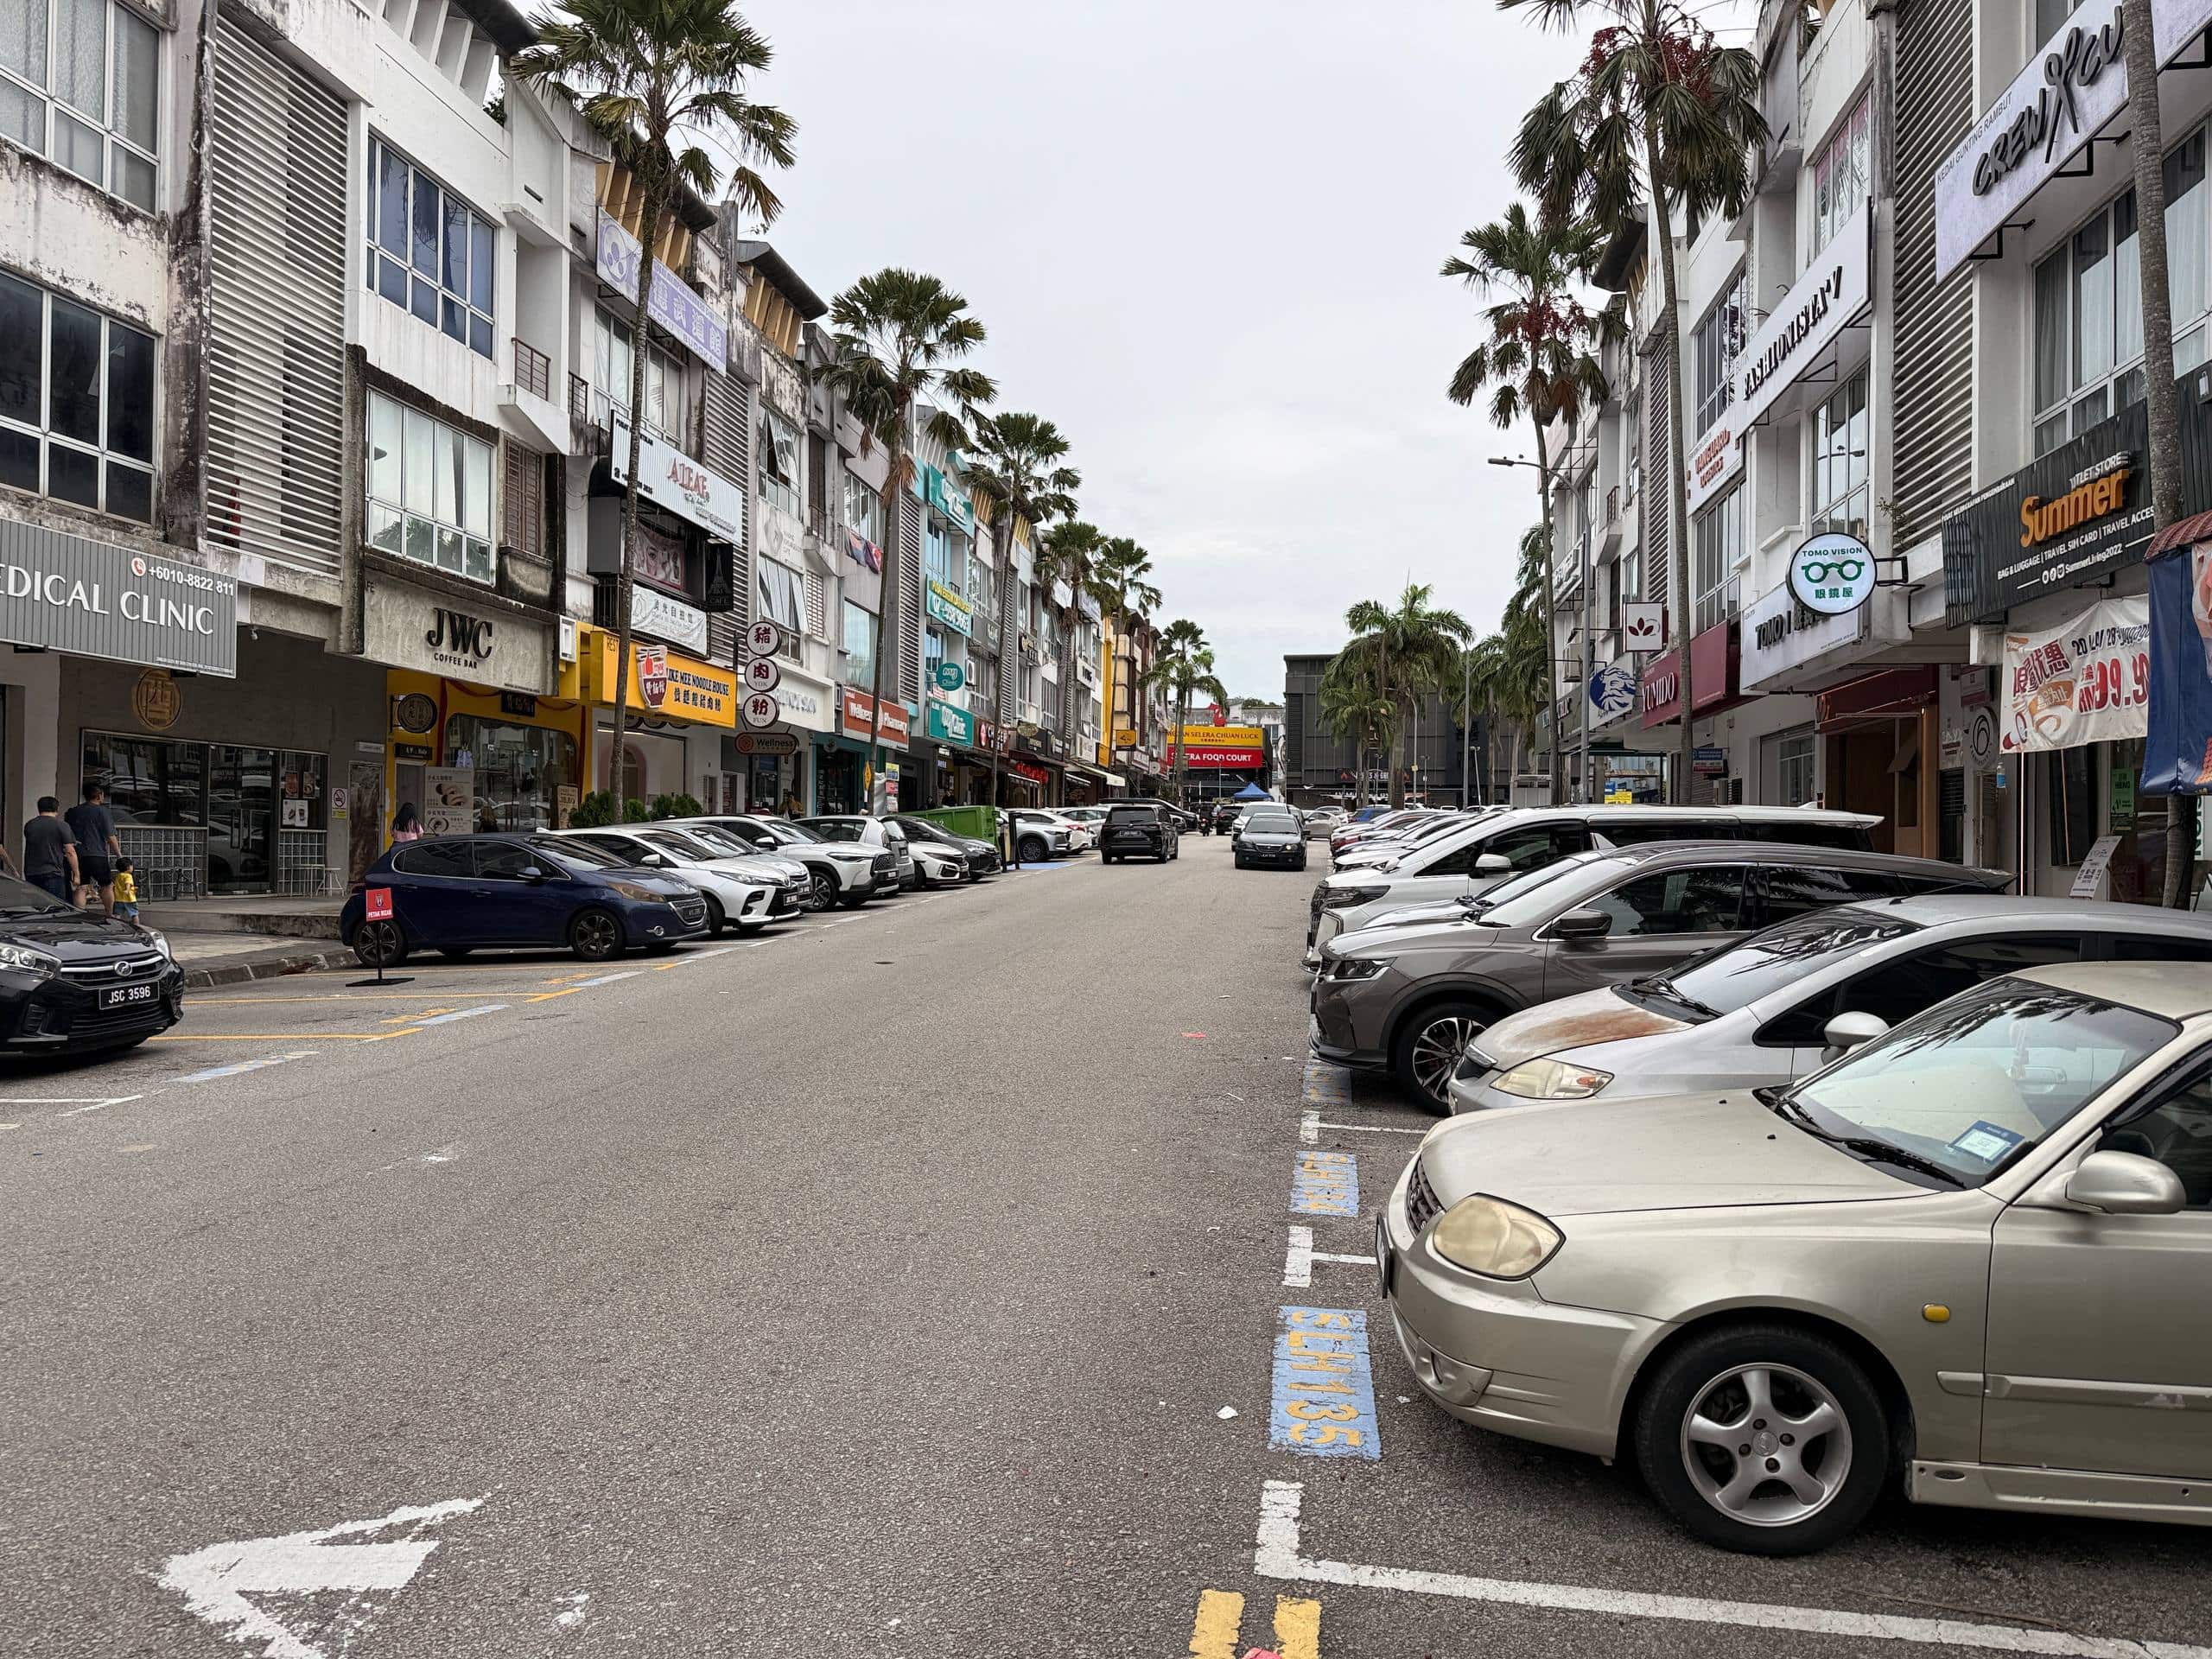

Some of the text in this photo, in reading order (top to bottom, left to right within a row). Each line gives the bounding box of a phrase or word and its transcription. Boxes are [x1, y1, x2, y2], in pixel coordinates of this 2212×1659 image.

[1936, 92, 2013, 185] KEDAI GUNTING RAMBUT
[1972, 87, 2047, 197] CREW
[2094, 452, 2126, 477] STORE
[2020, 469, 2130, 548] Summer
[1831, 546, 1863, 555] VISION
[1997, 566, 2009, 581] BAG
[2013, 555, 2041, 575] LUGGAGE
[2044, 541, 2067, 560] TRAVEL
[2079, 530, 2098, 549] CARD
[2103, 518, 2130, 539] TRAVEL
[149, 566, 213, 591] +6010-8822
[1815, 587, 1853, 599] 眼鏡屋
[119, 591, 214, 636] CLINIC
[426, 607, 493, 659] JWC
[1755, 613, 1785, 651] TOMO
[434, 652, 478, 670] COFFEE BAR
[753, 662, 770, 680] 肉
[679, 670, 692, 686] MEE
[691, 674, 712, 692] NOODLE
[712, 679, 730, 696] HOUSE
[1642, 671, 1675, 713] YUMIDO
[752, 698, 769, 715] 粉
[756, 738, 793, 747] Wellness
[108, 984, 150, 1004] JSC 3596
[1285, 1310, 1362, 1447] SLH135
